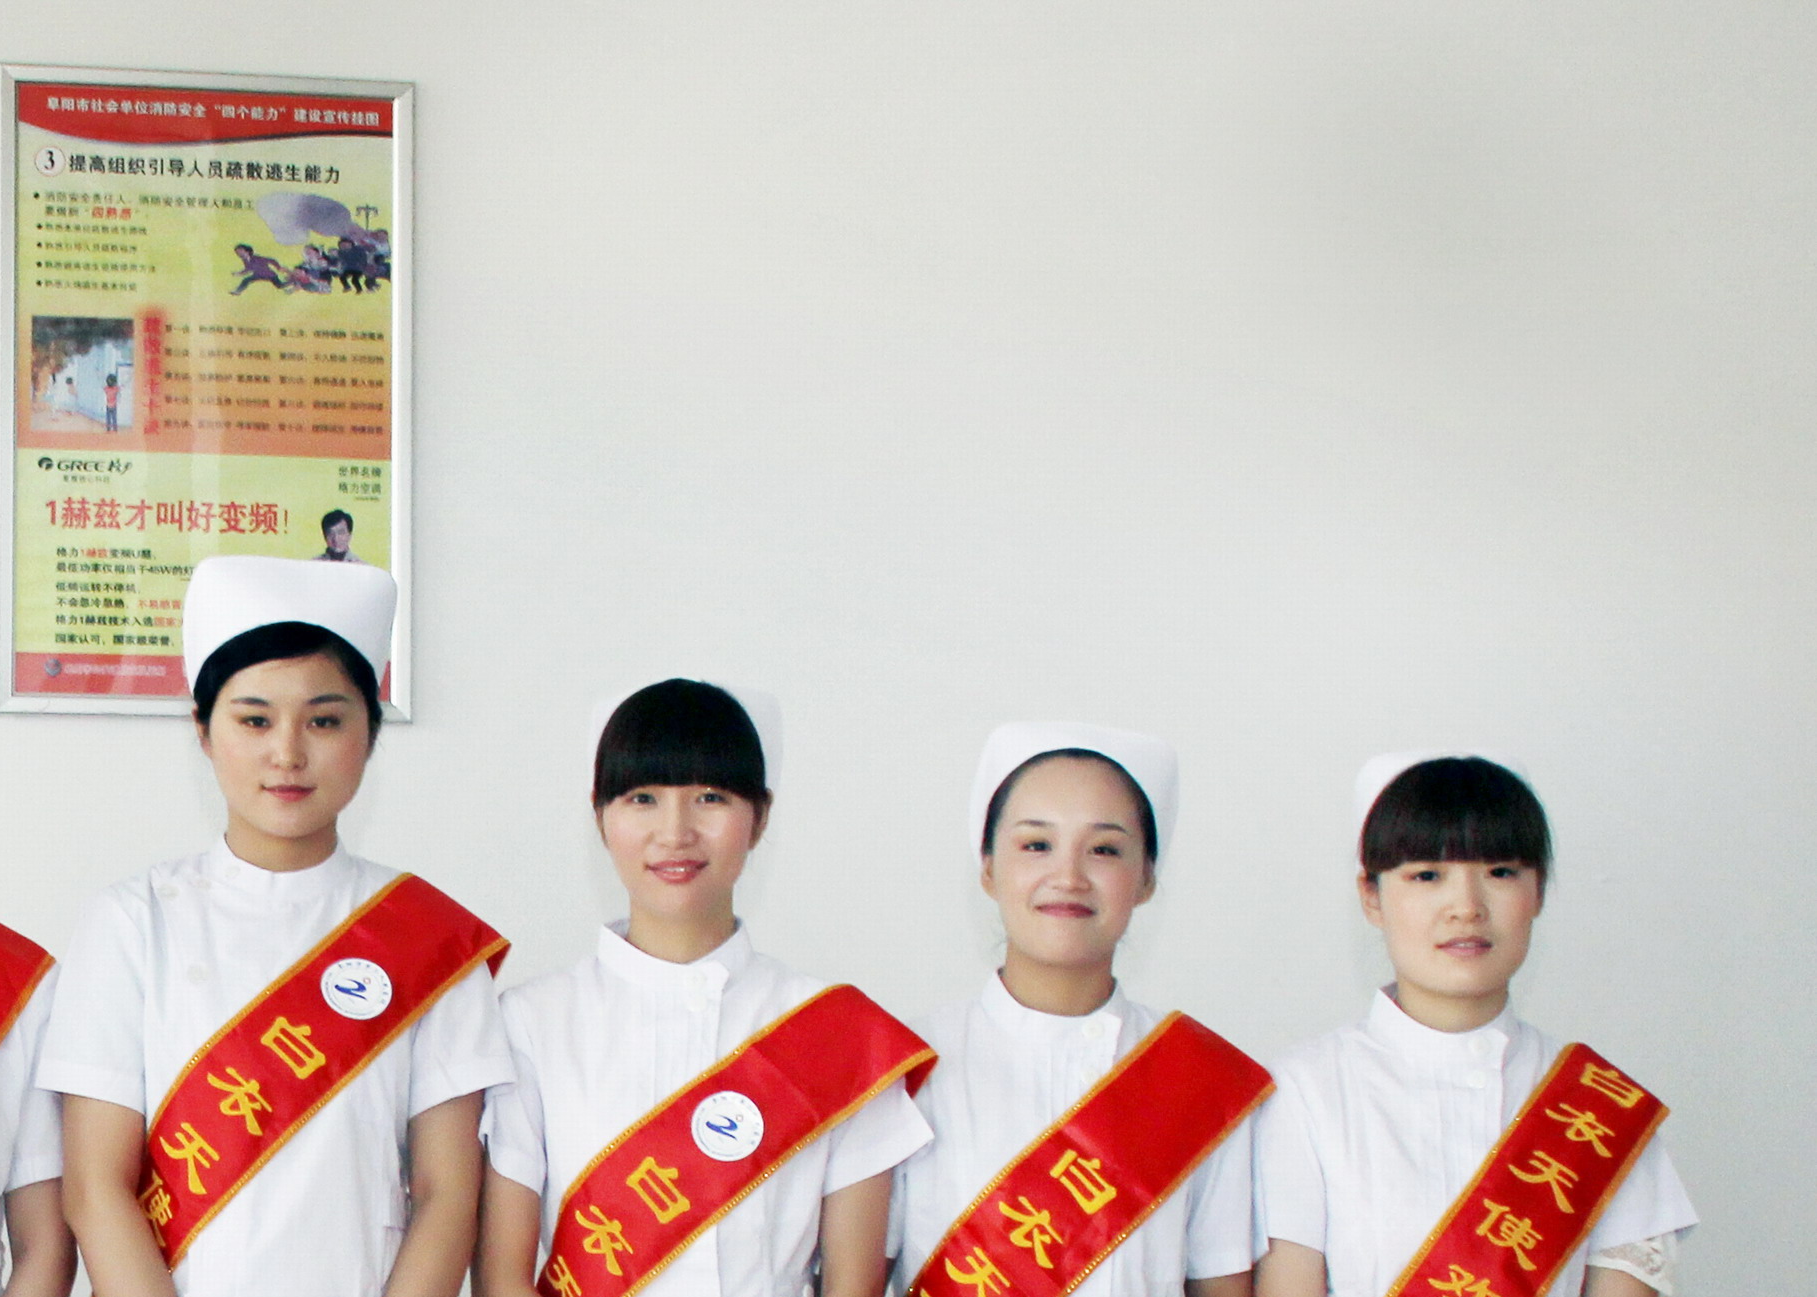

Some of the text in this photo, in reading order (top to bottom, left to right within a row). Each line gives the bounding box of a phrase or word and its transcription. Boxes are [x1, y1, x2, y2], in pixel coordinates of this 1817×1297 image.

[69, 154, 340, 184] 提高组织引导人员疏散逃生能力
